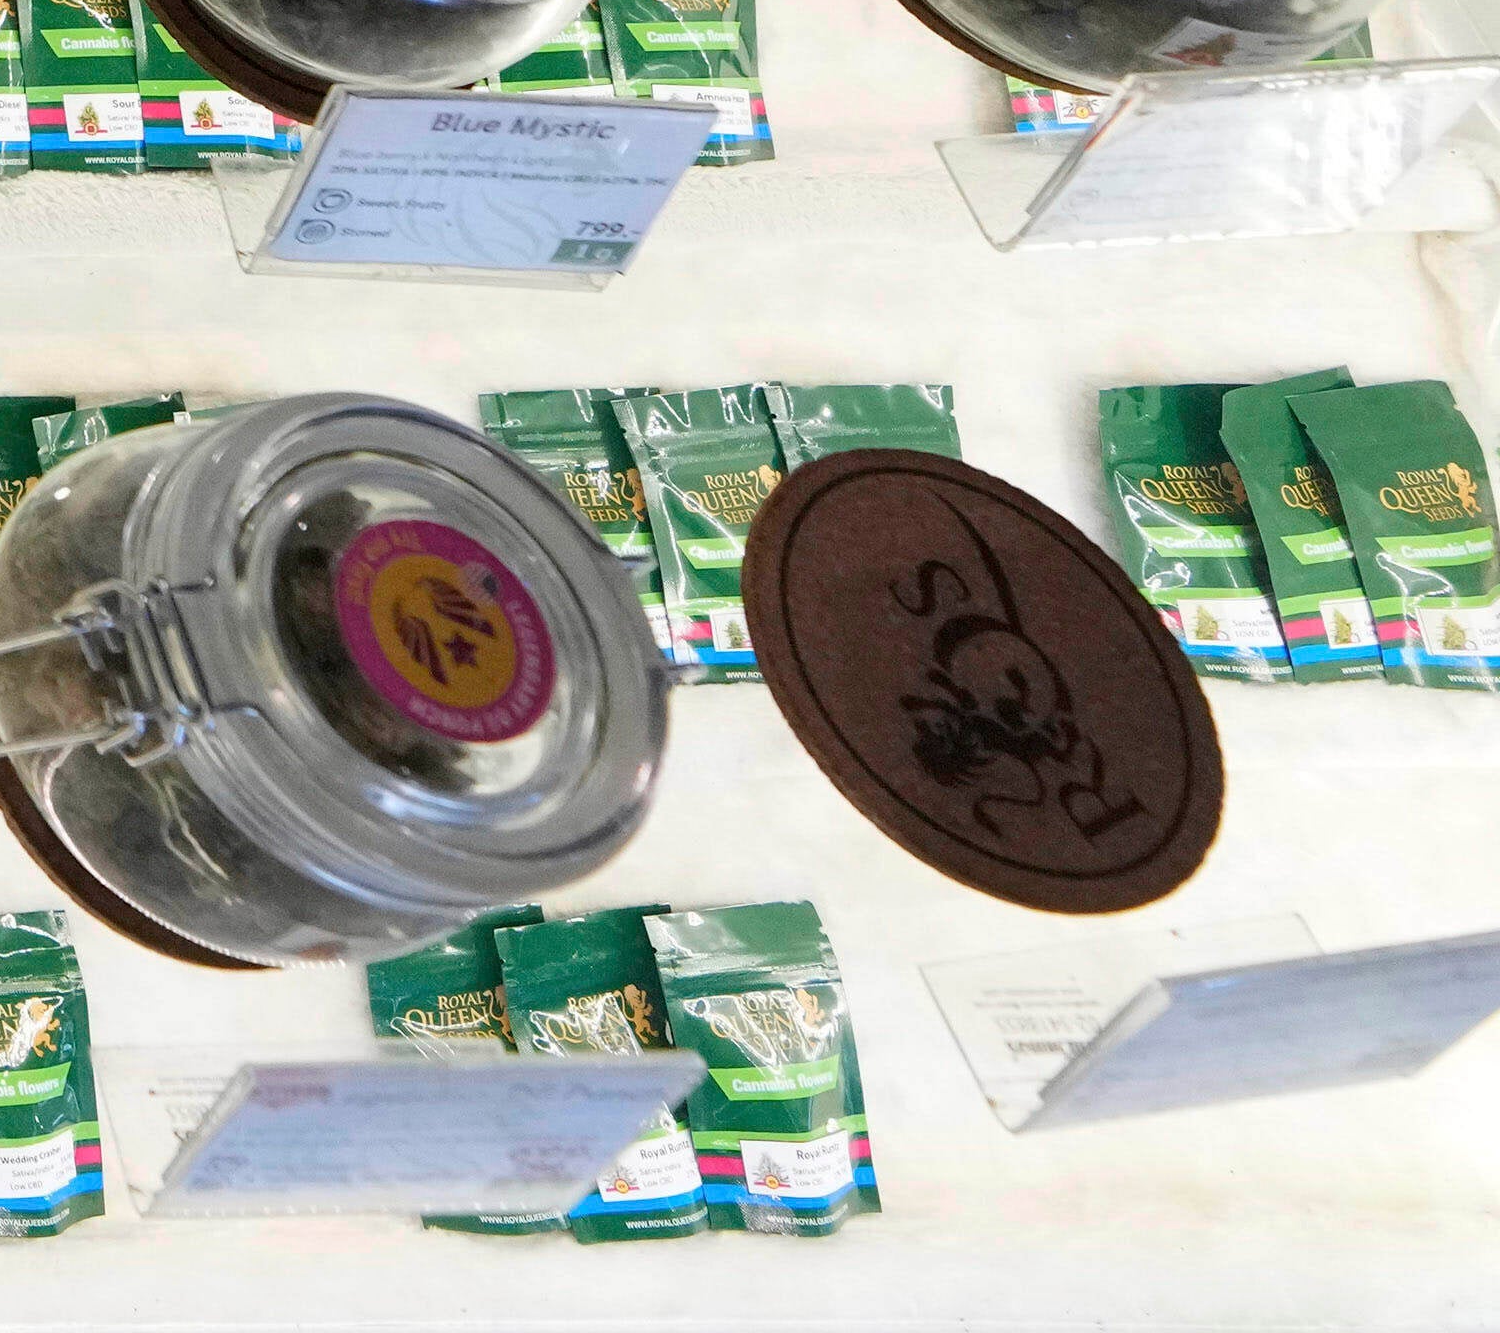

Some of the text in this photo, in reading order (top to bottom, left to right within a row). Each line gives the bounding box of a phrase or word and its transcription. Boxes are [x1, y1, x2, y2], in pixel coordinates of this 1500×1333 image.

[61, 37, 120, 52] Cannabis
[112, 99, 135, 109] Sour
[431, 112, 617, 141] Blue Mystic
[1162, 464, 1212, 480] ROYAL
[1397, 467, 1444, 487] ROYAL
[704, 473, 752, 489] ROYAL
[1140, 477, 1224, 504] QUEEN
[1379, 481, 1453, 511] QUEEN
[684, 487, 759, 513] QUEEN
[1190, 500, 1234, 515] SEEDS
[1422, 504, 1465, 522] SEEDS
[437, 992, 484, 1010] ROYAL
[18, 1077, 60, 1096] flowers
[732, 1078, 796, 1093] Cannabis
[0, 1155, 33, 1166] Wedding
[640, 1146, 666, 1160] Royal
[796, 1149, 820, 1161] Royal
